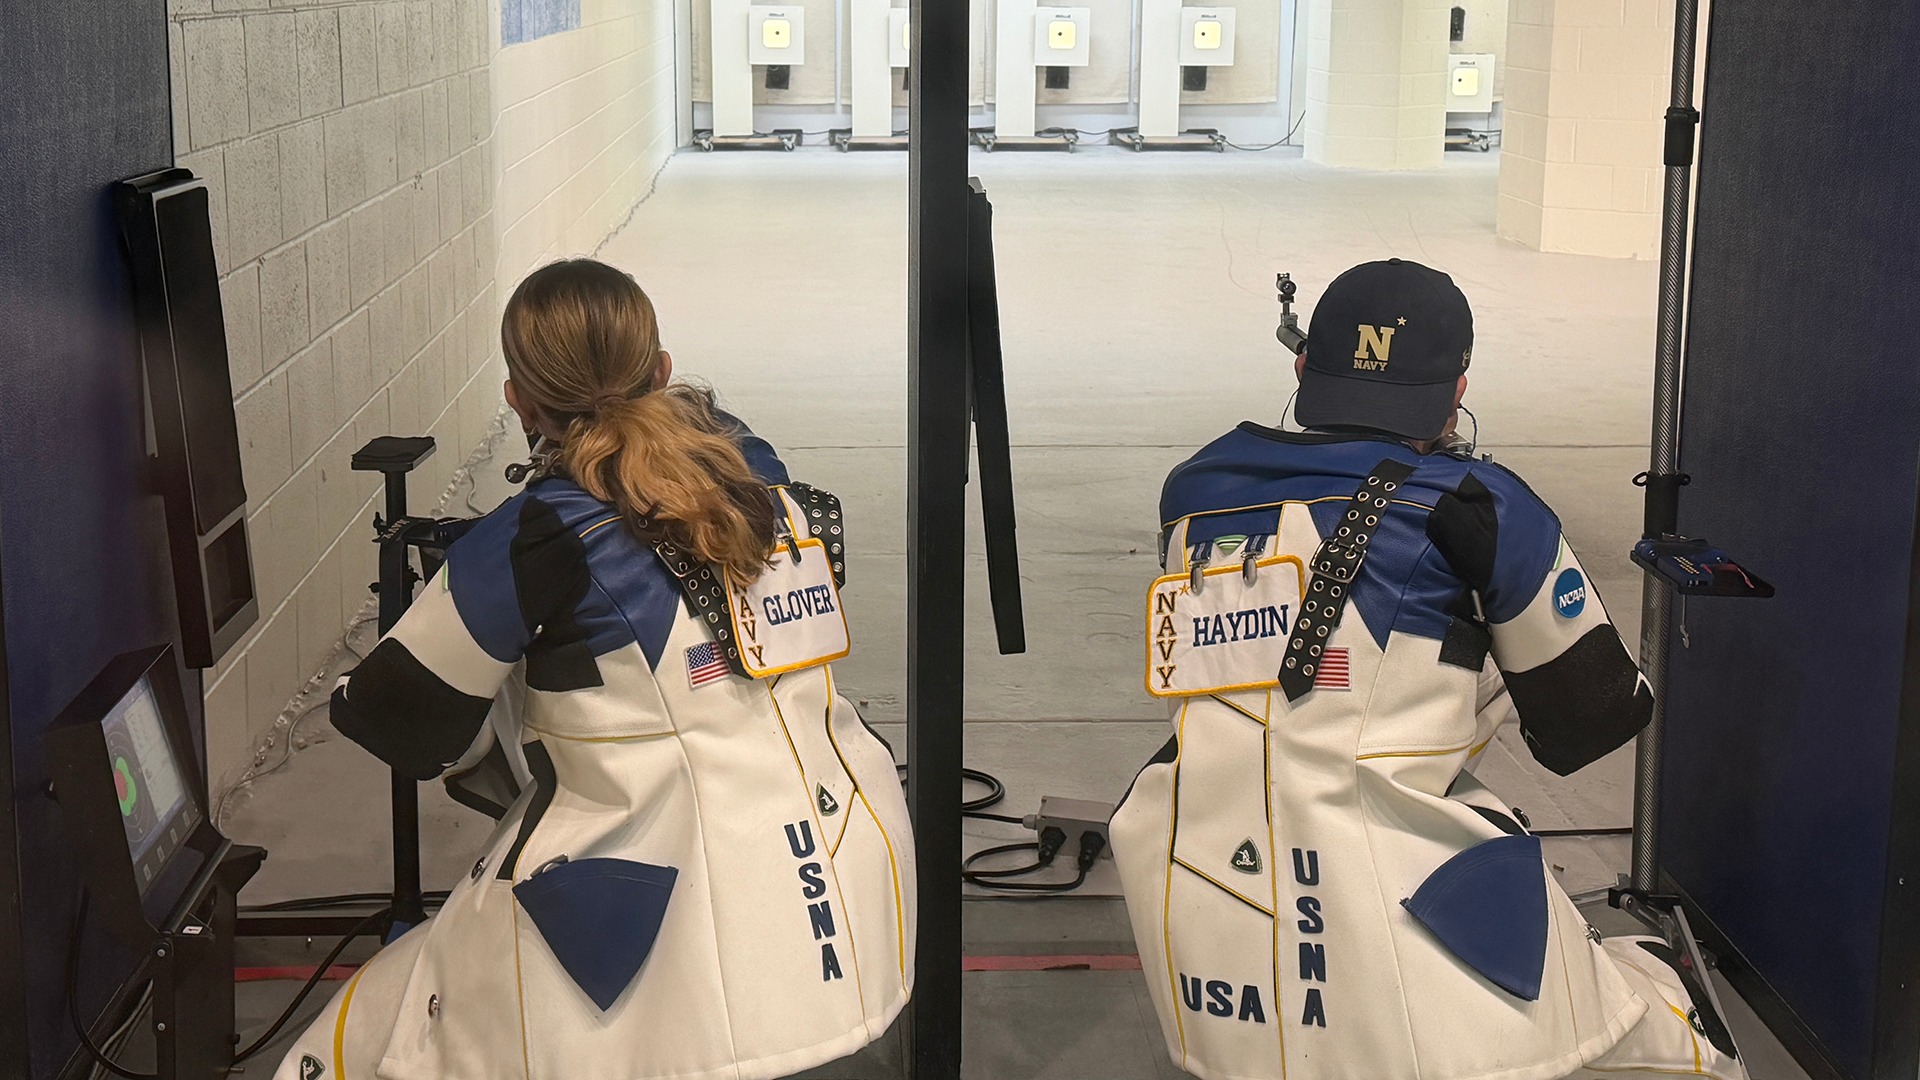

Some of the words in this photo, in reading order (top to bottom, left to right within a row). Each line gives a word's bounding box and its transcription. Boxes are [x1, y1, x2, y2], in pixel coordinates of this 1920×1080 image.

[1354, 324, 1395, 361] N
[1353, 359, 1388, 372] NAVY
[762, 584, 835, 626] GLOVER
[1558, 586, 1585, 609] NCAA
[1156, 591, 1177, 689] NAVY
[1193, 604, 1289, 647] HAYDIN
[783, 820, 843, 982] USNA
[1292, 848, 1327, 1029] USNA
[1179, 972, 1266, 1024] USA
